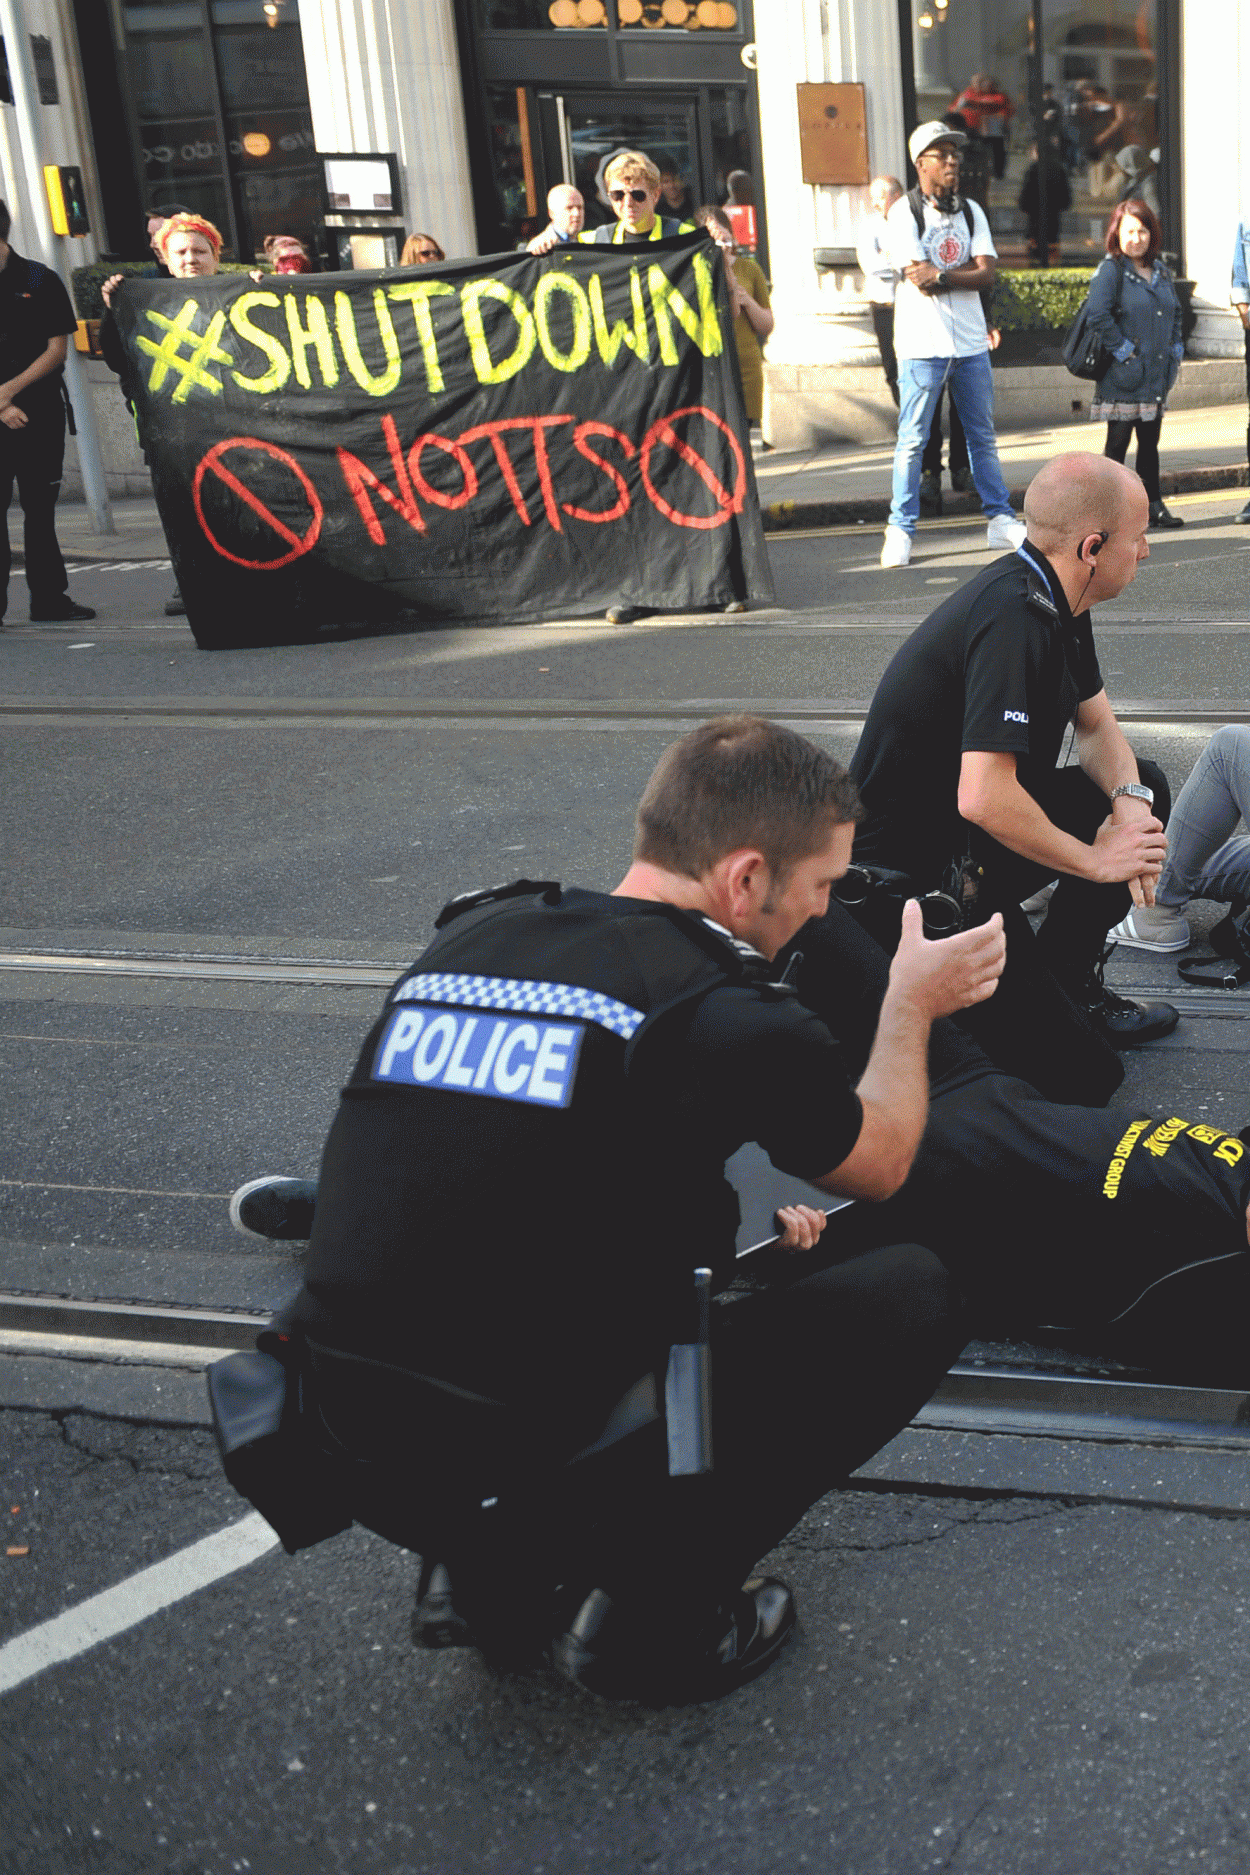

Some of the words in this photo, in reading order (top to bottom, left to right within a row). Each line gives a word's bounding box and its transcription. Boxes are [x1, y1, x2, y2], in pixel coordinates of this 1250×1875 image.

[136, 252, 723, 403] #SHUTDOWN
[335, 412, 634, 546] NOTTS
[1003, 710, 1029, 723] POL
[378, 1009, 575, 1102] POLICE
[1102, 1158, 1126, 1199] GROUP
